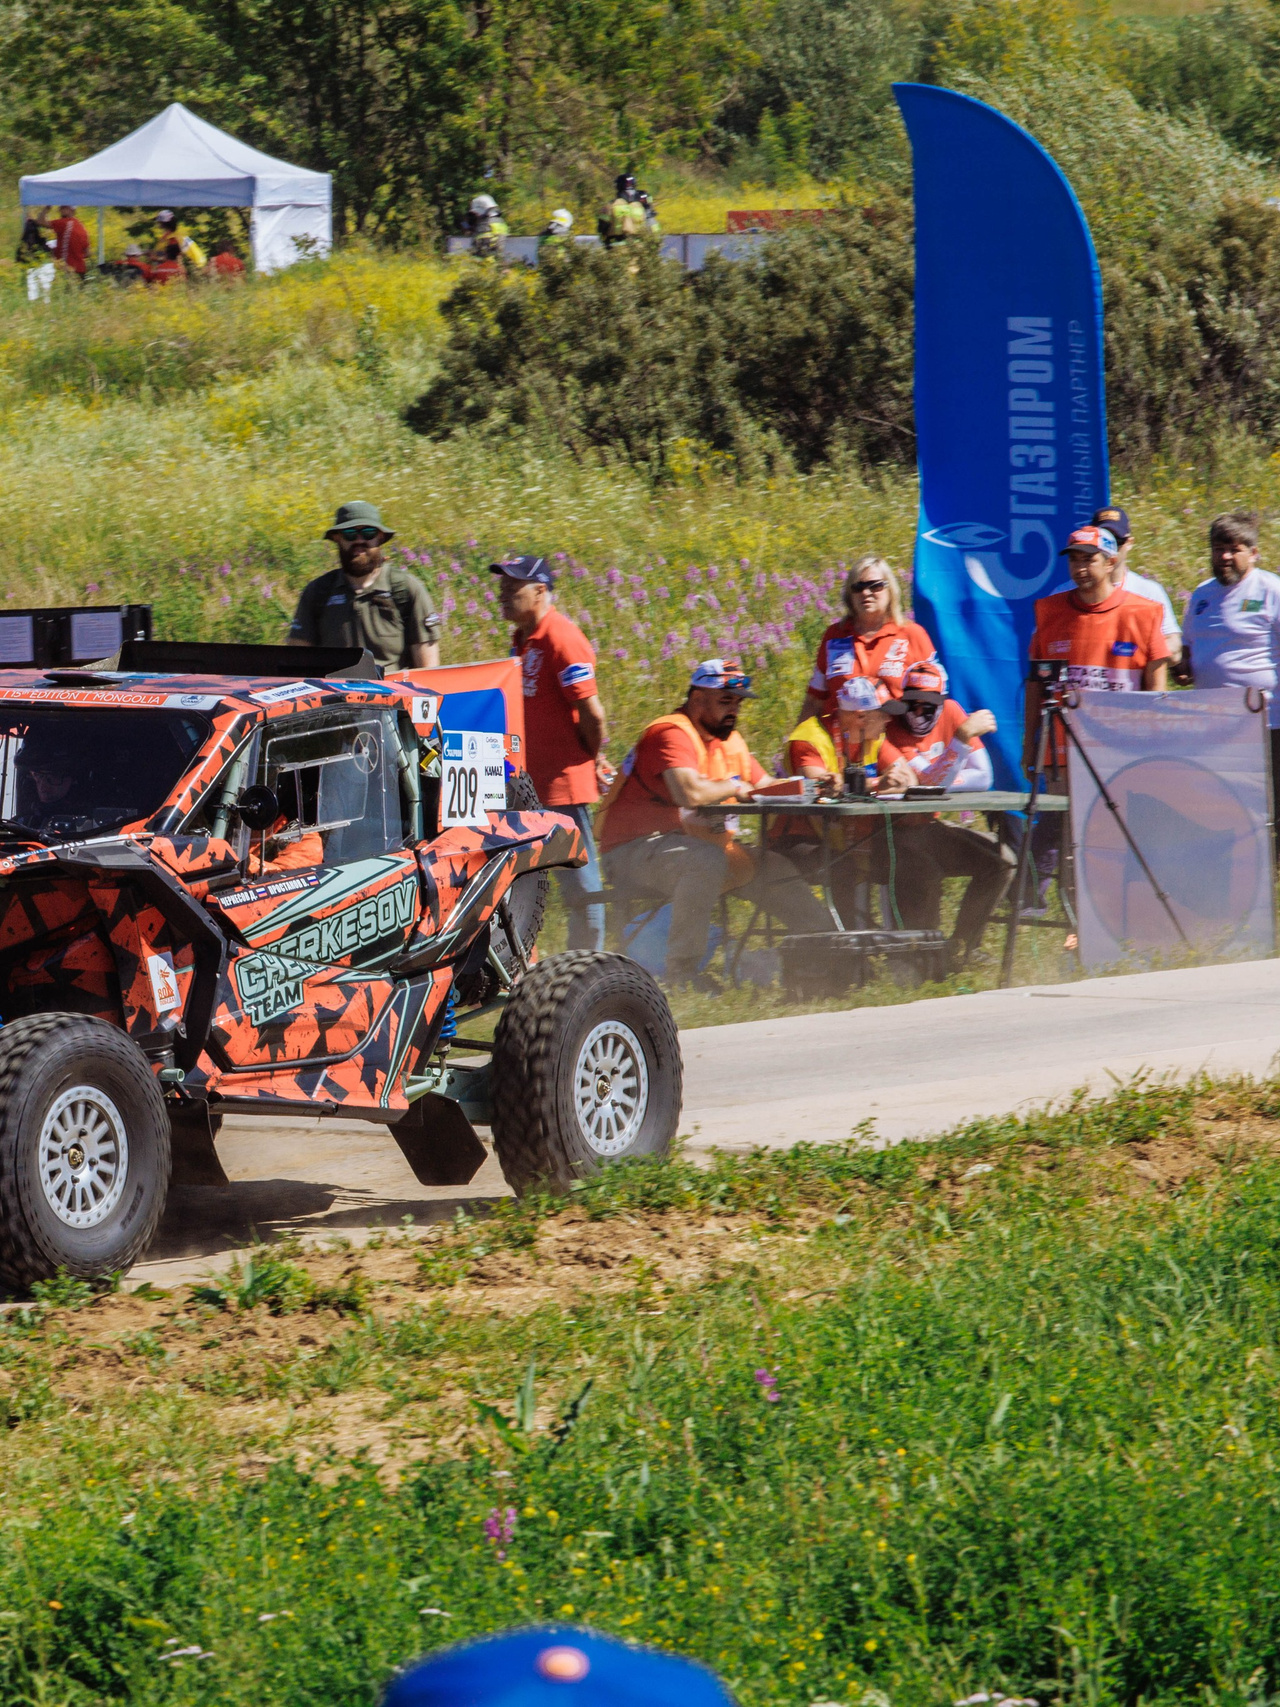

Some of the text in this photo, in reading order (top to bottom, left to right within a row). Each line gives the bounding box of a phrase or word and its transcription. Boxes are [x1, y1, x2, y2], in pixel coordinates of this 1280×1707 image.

[1007, 316, 1058, 515] ГАЗПРОМ
[29, 690, 80, 700] EDITION
[93, 691, 160, 704] MONGOLIA
[484, 765, 503, 776] KAMAZ
[447, 766, 478, 819] 209
[235, 876, 418, 1001] CHERKESOV
[158, 987, 168, 998] 80
[246, 981, 302, 1022] TEAM
